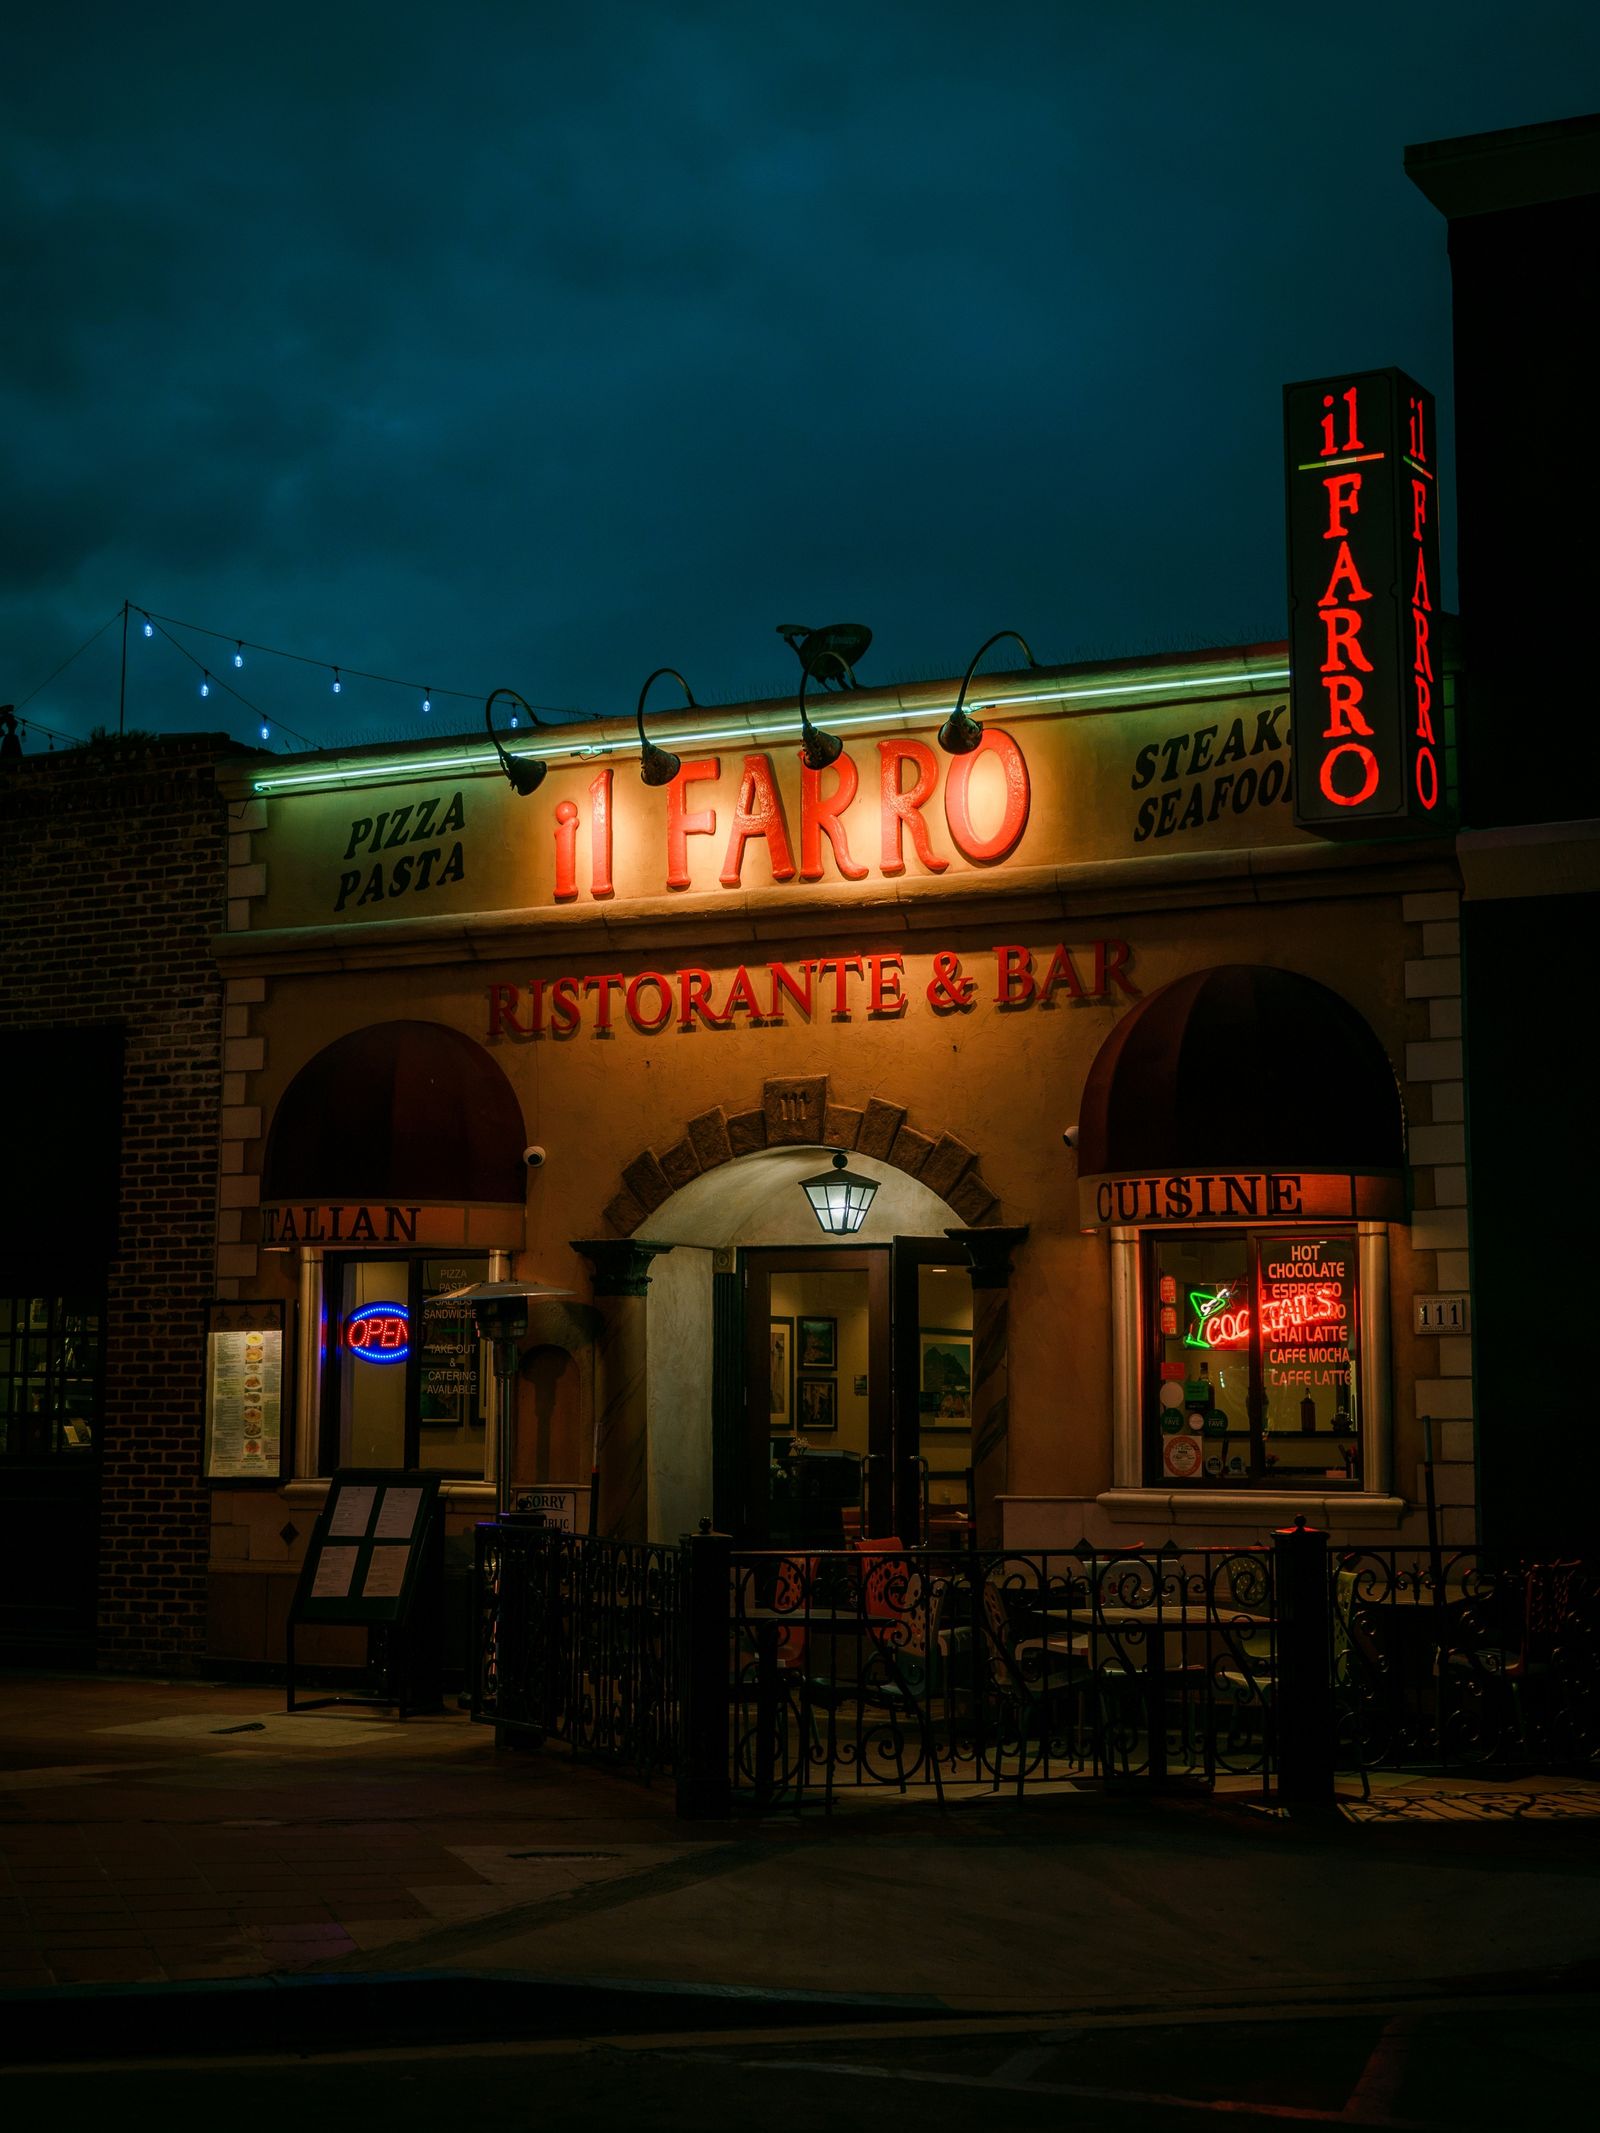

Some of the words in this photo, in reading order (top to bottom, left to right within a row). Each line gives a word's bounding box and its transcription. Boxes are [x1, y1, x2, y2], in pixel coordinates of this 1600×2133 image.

[1319, 386, 1366, 457] il
[1408, 397, 1427, 463] il
[1317, 472, 1381, 807] FARRO
[1411, 479, 1439, 812] FARRO
[1131, 705, 1292, 790] STEAK
[343, 791, 465, 859] PIZZA
[553, 769, 614, 900] il
[666, 728, 1031, 889] FARRO
[334, 842, 465, 912] PASTA
[487, 953, 906, 1036] RISTORANTE
[927, 950, 975, 1008] &
[992, 938, 1141, 1005] BAR
[1097, 1176, 1302, 1222] CUISINE
[1291, 1245, 1320, 1261] HOT
[440, 1269, 467, 1280] PIZZA
[1268, 1262, 1345, 1279] CHOCOLATE
[1272, 1282, 1342, 1300] ESPRESSO
[424, 1308, 477, 1319] SANDWICHE
[1421, 1304, 1459, 1326] 111
[348, 1318, 408, 1348] OPEN
[1271, 1327, 1302, 1343] CHAI
[1306, 1326, 1347, 1342] LATTE
[1269, 1349, 1306, 1364] CAFFE
[1309, 1348, 1350, 1363] MOCHA
[428, 1371, 477, 1381] CATERING
[1271, 1370, 1311, 1386] CAFFE
[1314, 1370, 1351, 1386] LATTE
[427, 1384, 477, 1395] AVAILABLE
[527, 1495, 566, 1509] SORRY
